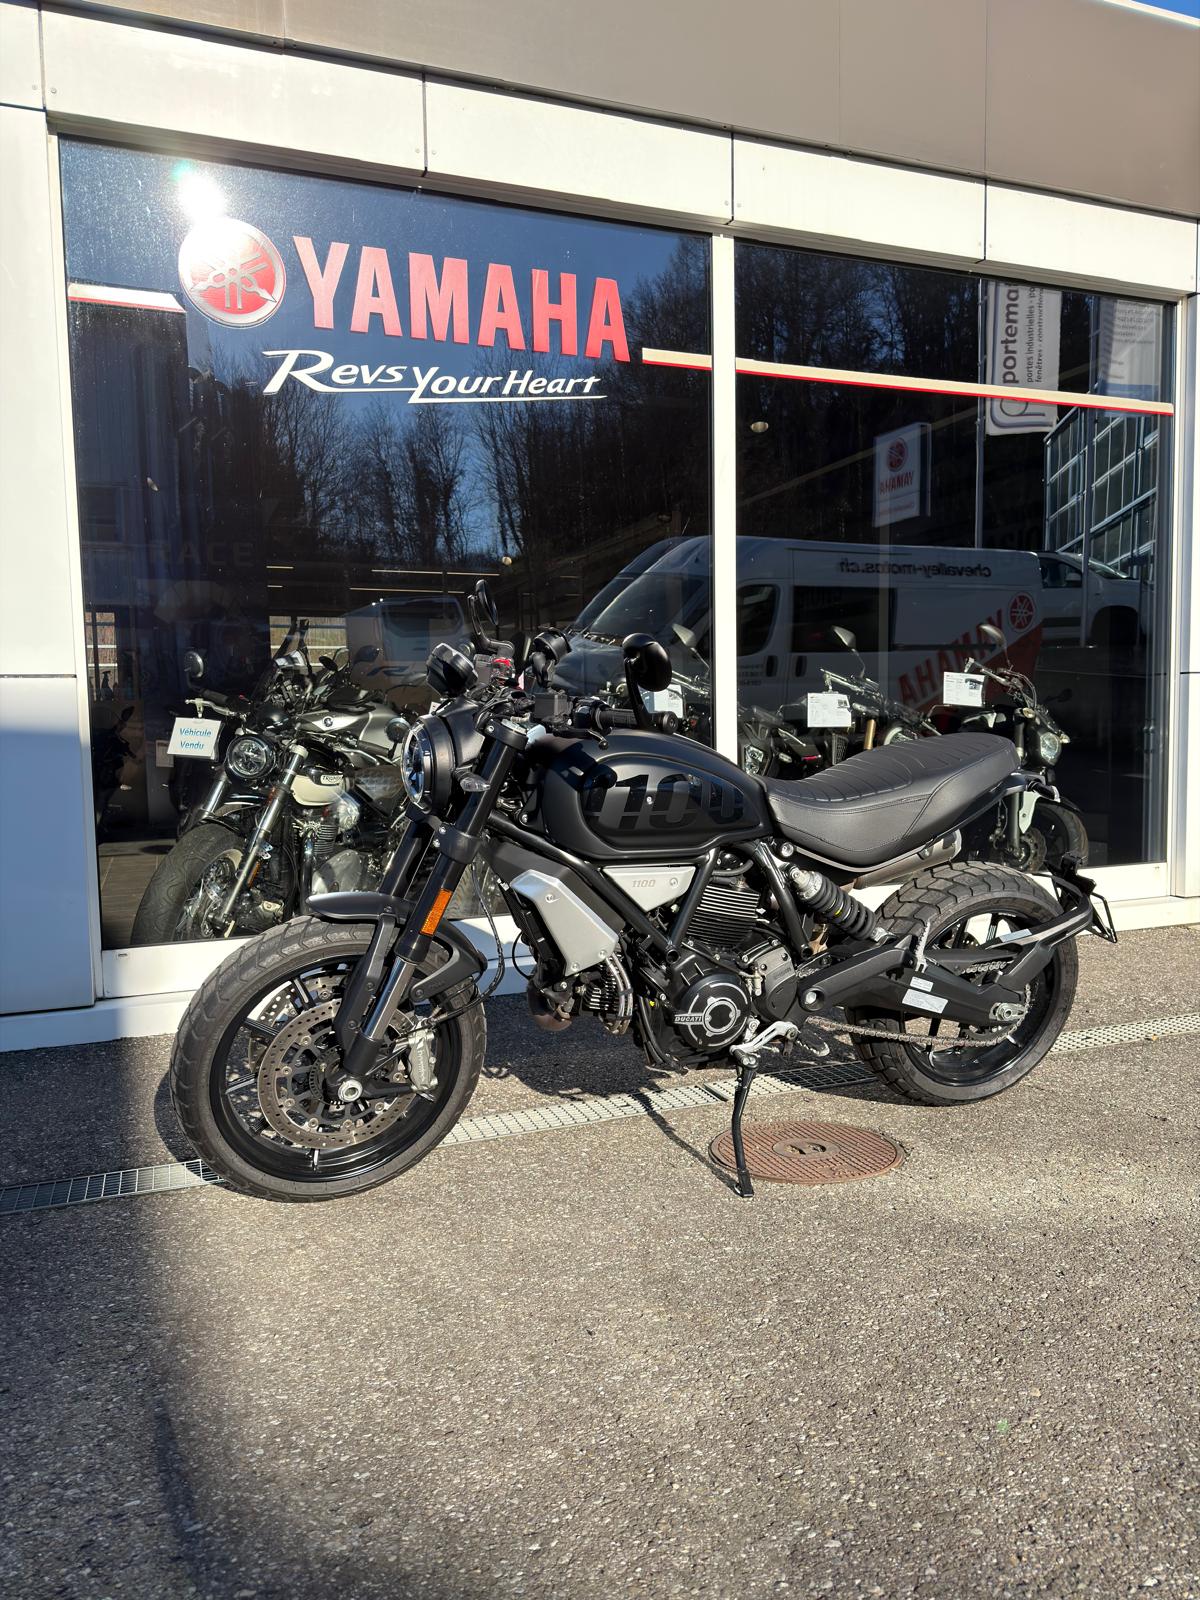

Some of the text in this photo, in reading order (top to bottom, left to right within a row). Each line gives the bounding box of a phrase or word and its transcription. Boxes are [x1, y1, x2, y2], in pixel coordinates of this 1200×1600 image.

[293, 235, 631, 363] YAMAHA
[1000, 284, 1020, 385] portema
[1025, 305, 1036, 355] industrielles
[262, 349, 602, 404] Revs Your Heart
[1025, 356, 1035, 383] portes
[179, 727, 212, 738] Véhicule
[180, 740, 205, 750] Vendu
[631, 879, 656, 888] 1100
